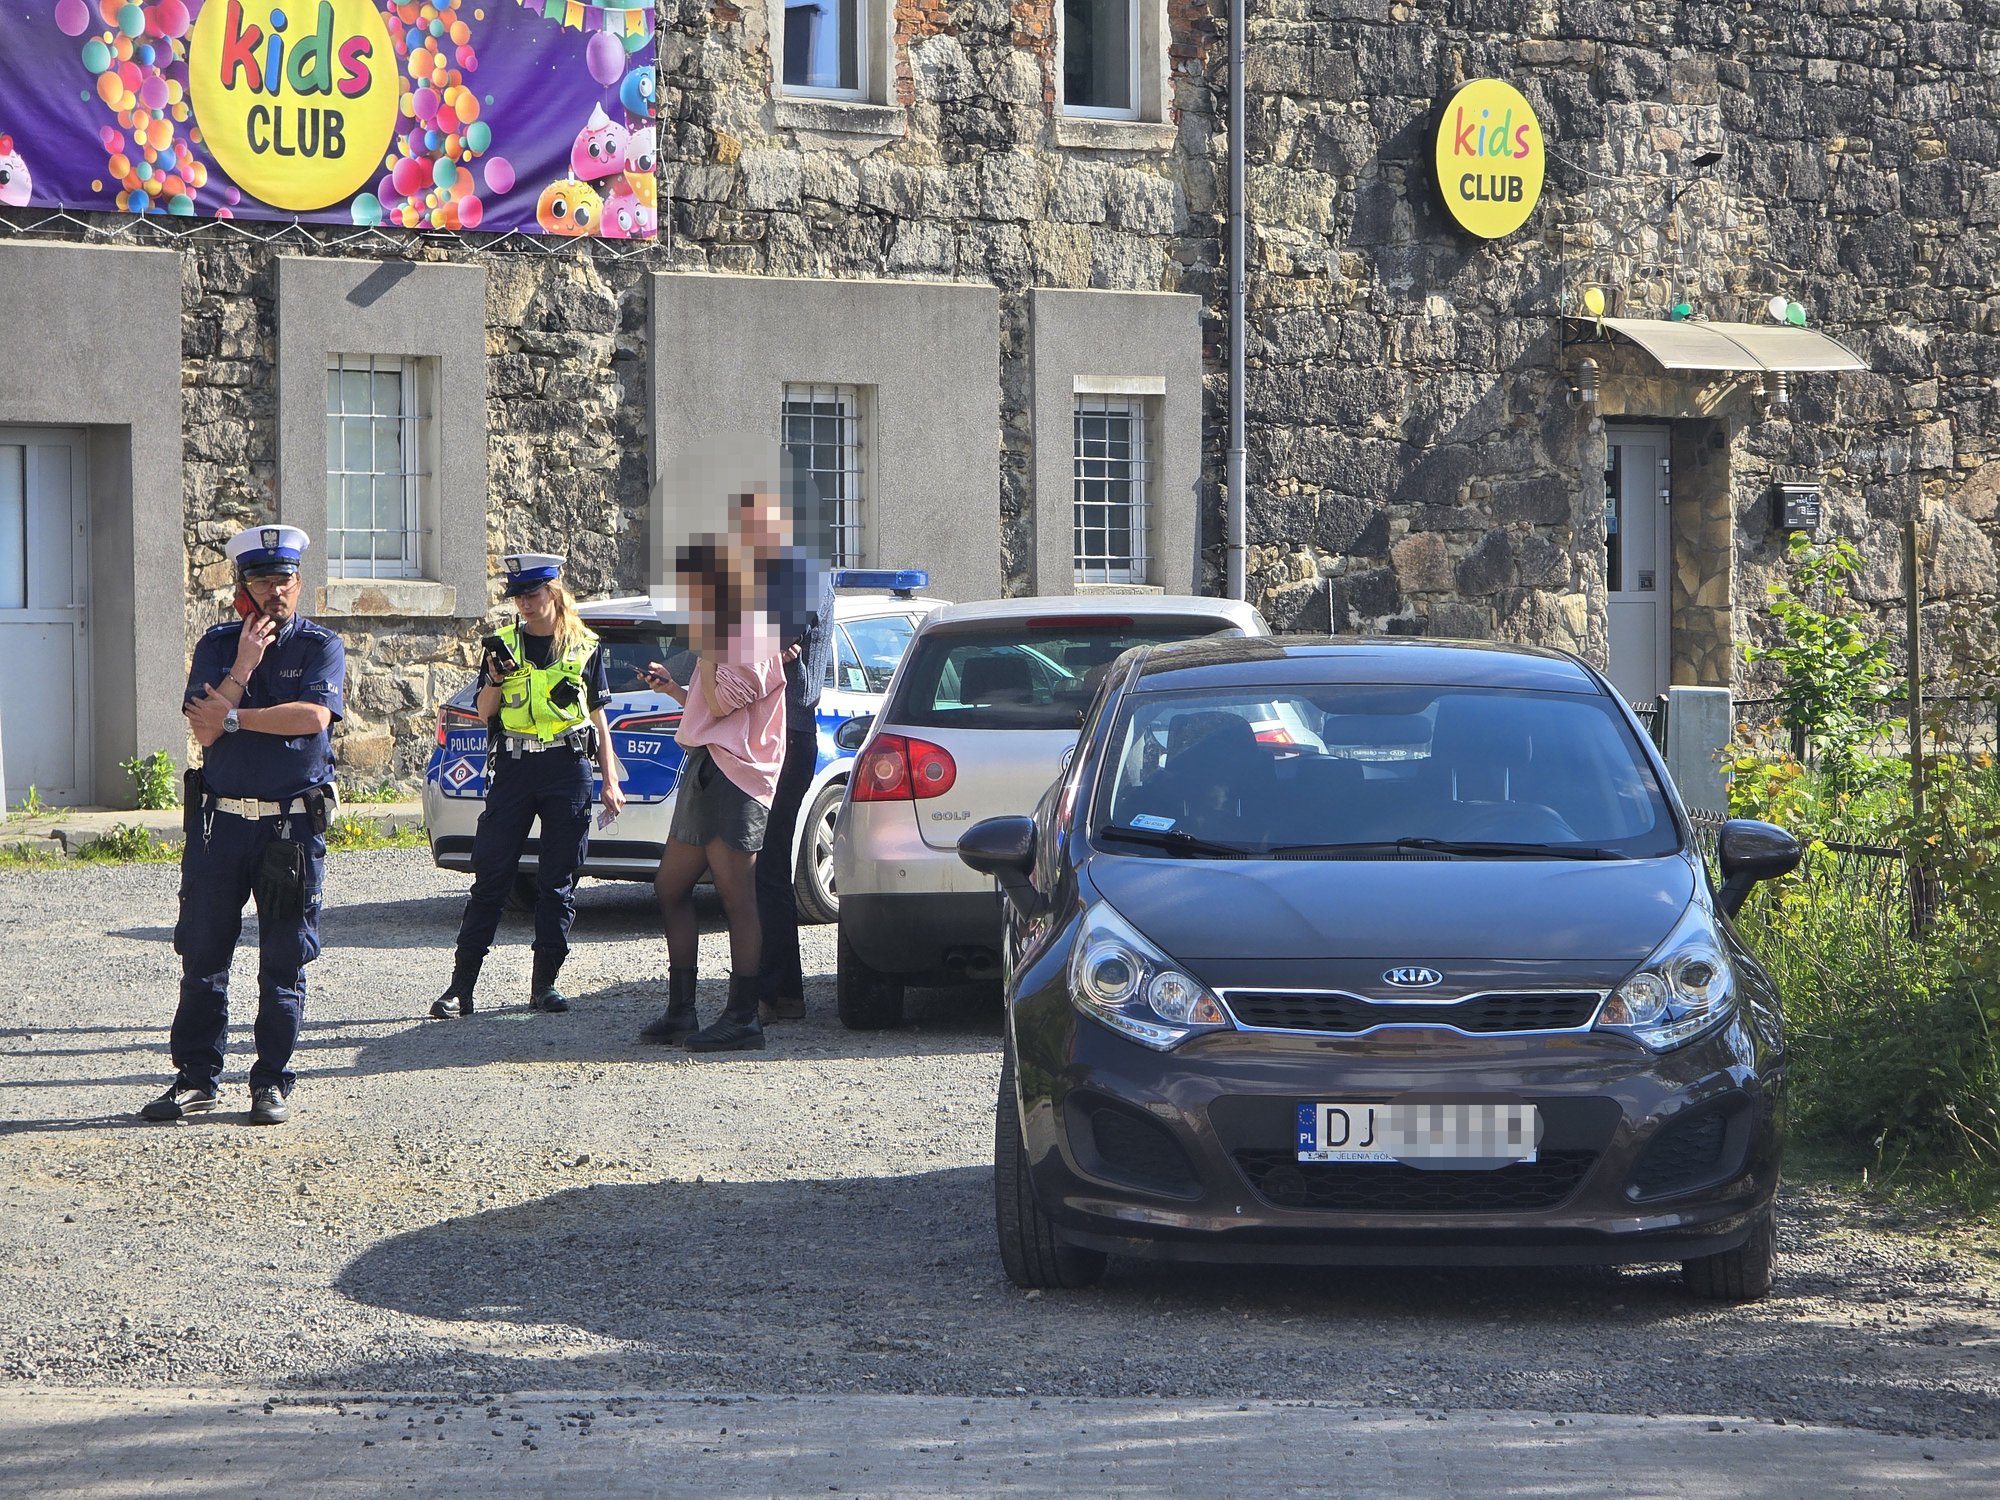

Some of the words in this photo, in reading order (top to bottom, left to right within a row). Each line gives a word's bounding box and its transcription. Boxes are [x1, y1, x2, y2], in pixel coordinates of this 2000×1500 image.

[221, 0, 373, 99] kids
[247, 104, 346, 159] CLUB
[1454, 106, 1530, 159] kids
[1459, 173, 1523, 202] CLUB
[451, 737, 487, 751] POLICJA
[628, 740, 661, 755] B577
[931, 810, 970, 820] GOLF
[1392, 969, 1433, 982] KIA
[1300, 1133, 1314, 1144] PL
[1326, 1108, 1374, 1147] DJ
